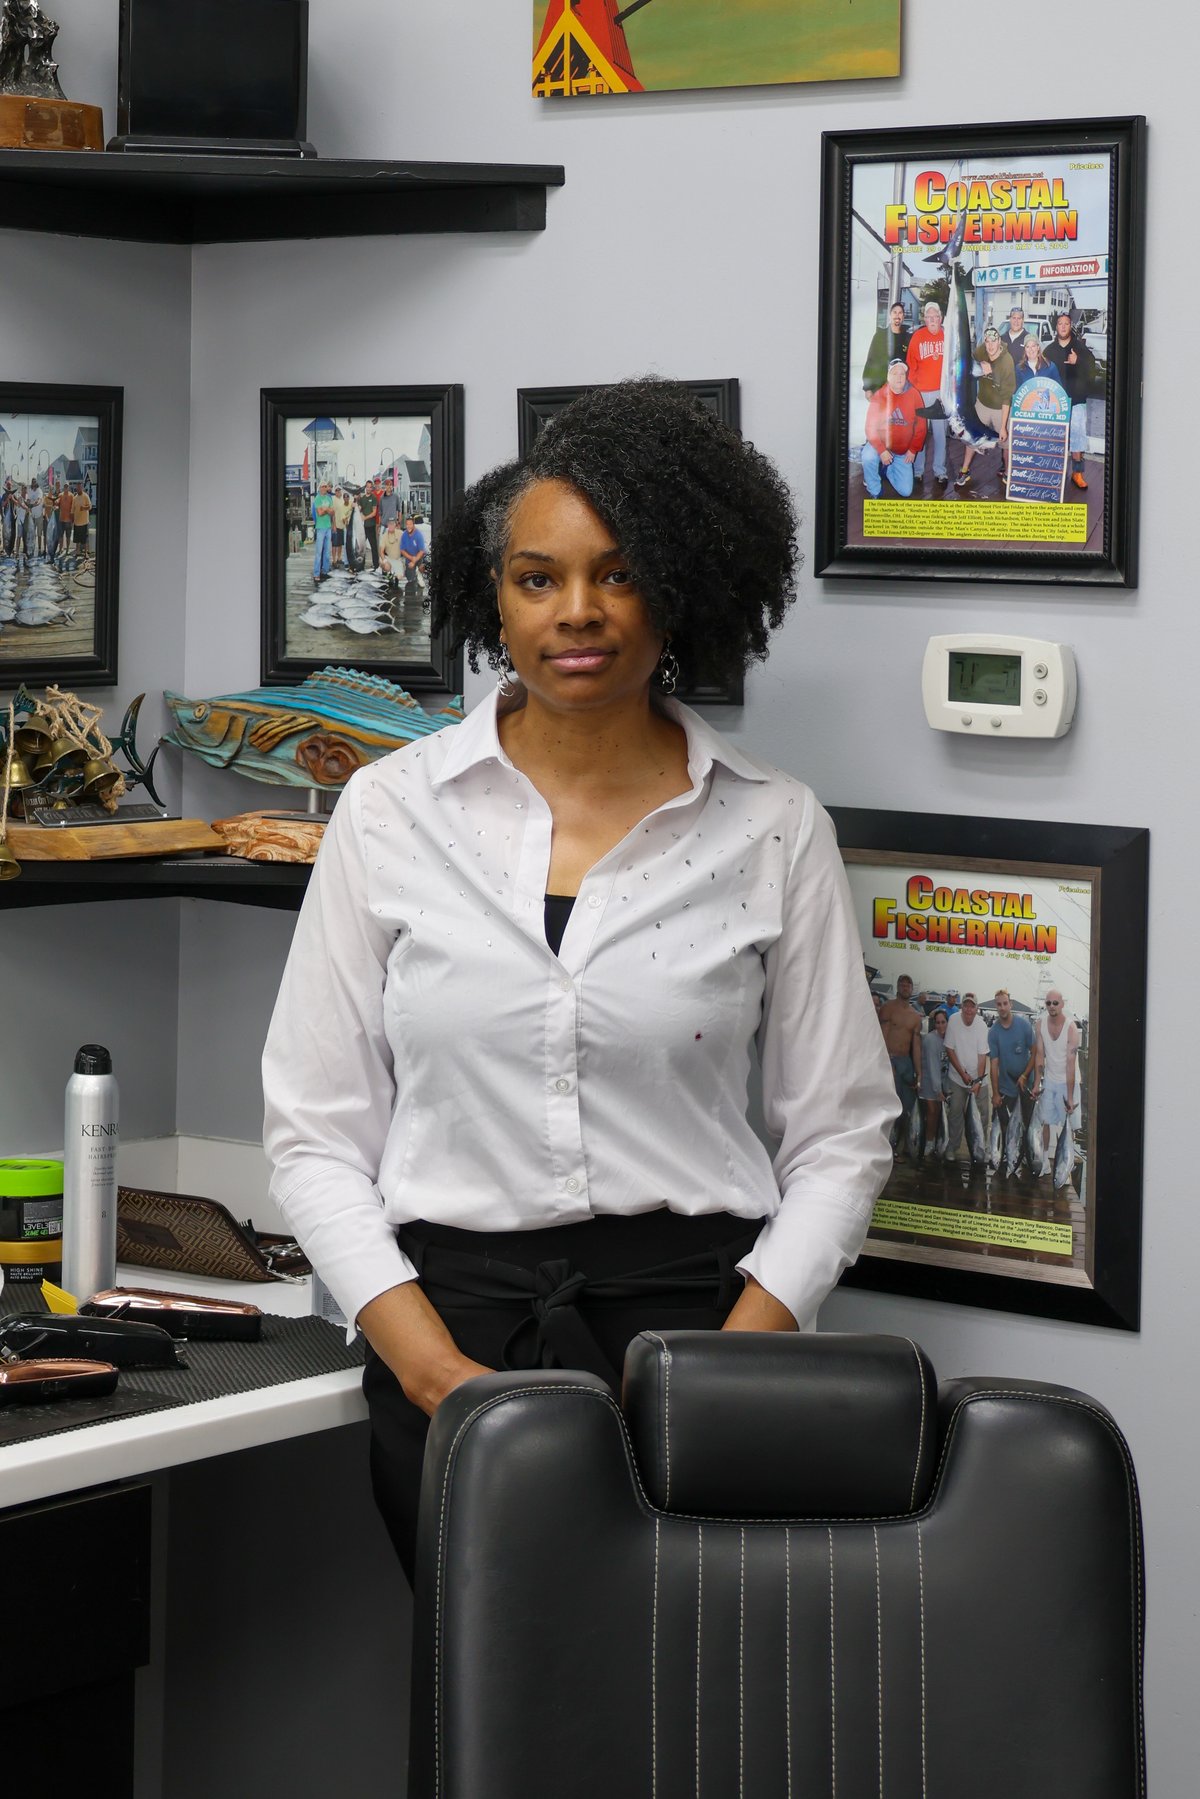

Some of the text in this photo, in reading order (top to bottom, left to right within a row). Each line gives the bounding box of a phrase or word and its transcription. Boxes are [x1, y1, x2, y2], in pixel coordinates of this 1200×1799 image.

[914, 170, 1069, 212] COASTAL
[885, 204, 1078, 245] FISHERMAN
[977, 264, 1095, 282] MOTEL INFORMATION
[906, 875, 1036, 919] COASTAL
[874, 897, 1057, 953] FISHERMAN
[878, 942, 906, 950] VOLUME
[926, 945, 954, 954] SPECIAL
[956, 948, 984, 956] EDITION
